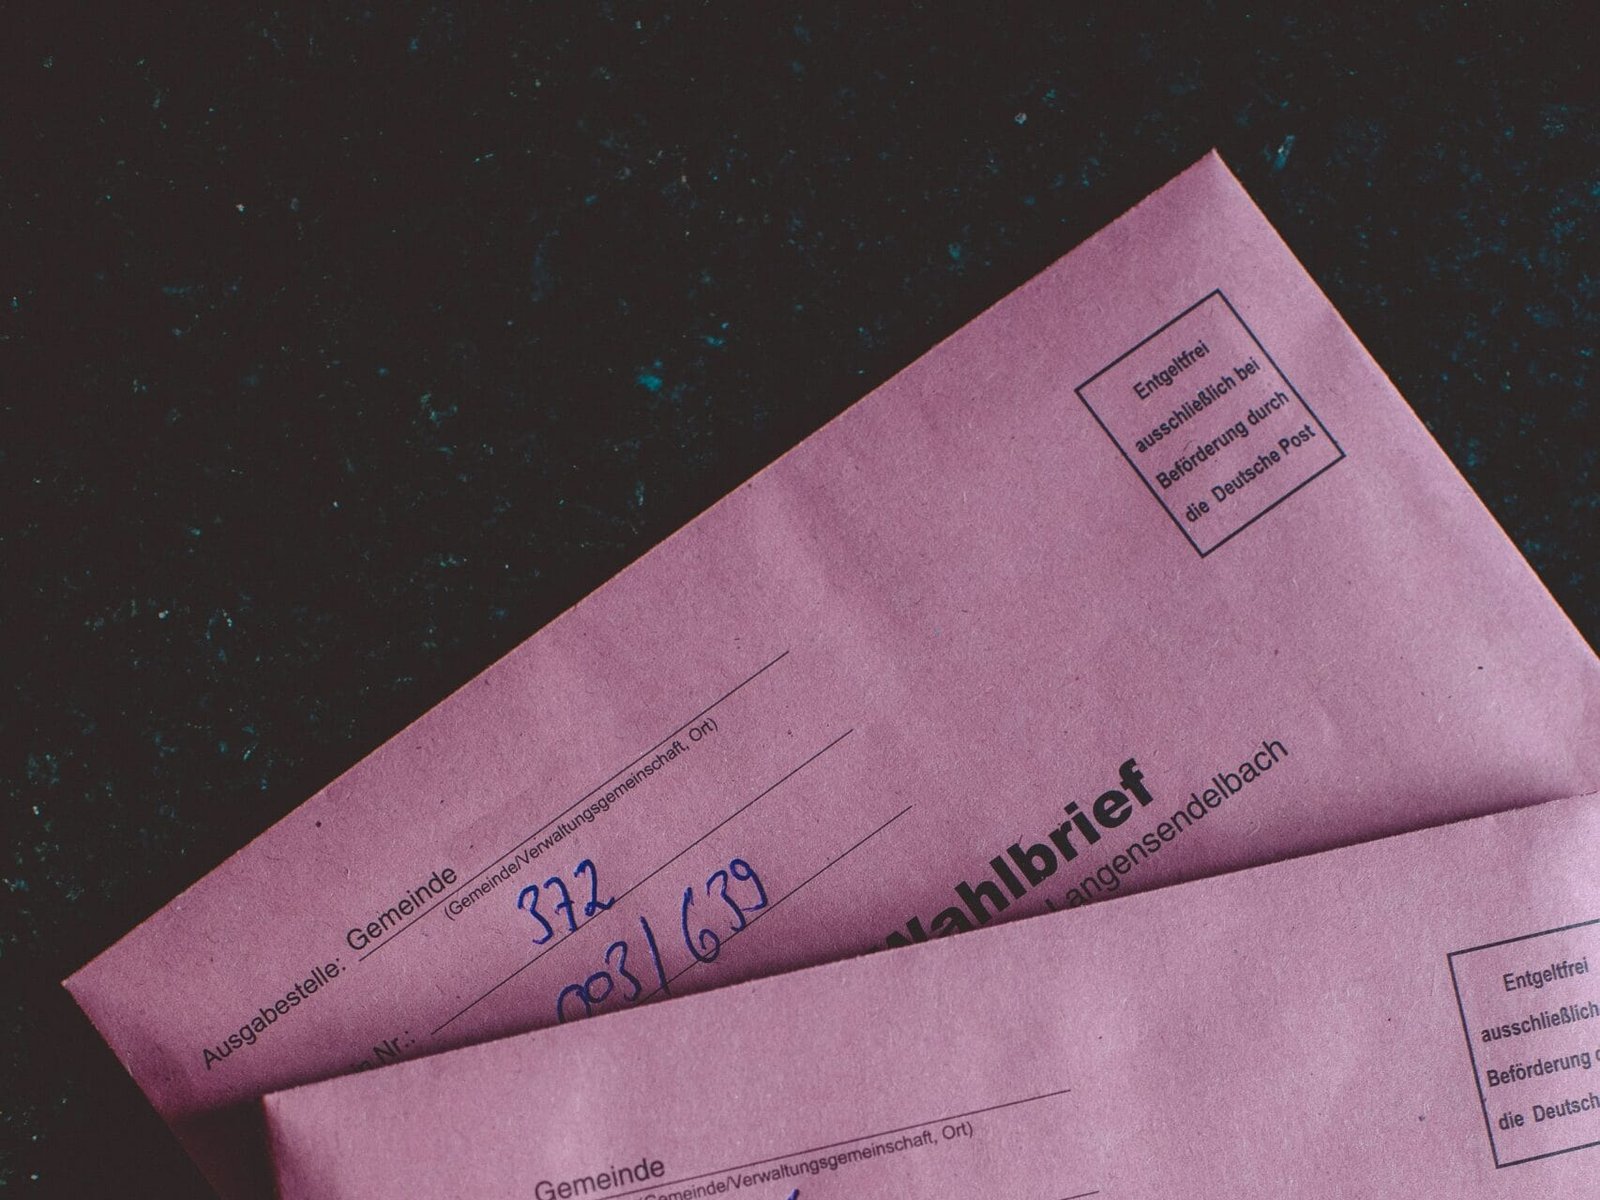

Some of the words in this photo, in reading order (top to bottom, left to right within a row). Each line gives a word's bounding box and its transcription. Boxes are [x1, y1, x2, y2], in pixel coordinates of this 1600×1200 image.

[1132, 340, 1210, 400] Entgeltfrei
[1135, 374, 1237, 453] ausschließlich
[1233, 356, 1261, 382] bei
[1156, 419, 1249, 489] Beförderung
[1247, 390, 1289, 427] durch
[1185, 499, 1210, 523] die
[1211, 449, 1281, 503] Deutsche
[1278, 423, 1316, 455] Post
[687, 716, 719, 745] Ort)
[516, 858, 617, 945] 372
[202, 956, 346, 1070] Ausgabestelle:
[346, 864, 458, 952] Gemeinde
[1503, 957, 1589, 992] Entgeltfrei
[1481, 1001, 1600, 1043] ausschließlich
[1486, 1050, 1592, 1088] Beförderung
[941, 1120, 974, 1142] Ort)
[1498, 1111, 1525, 1131] die
